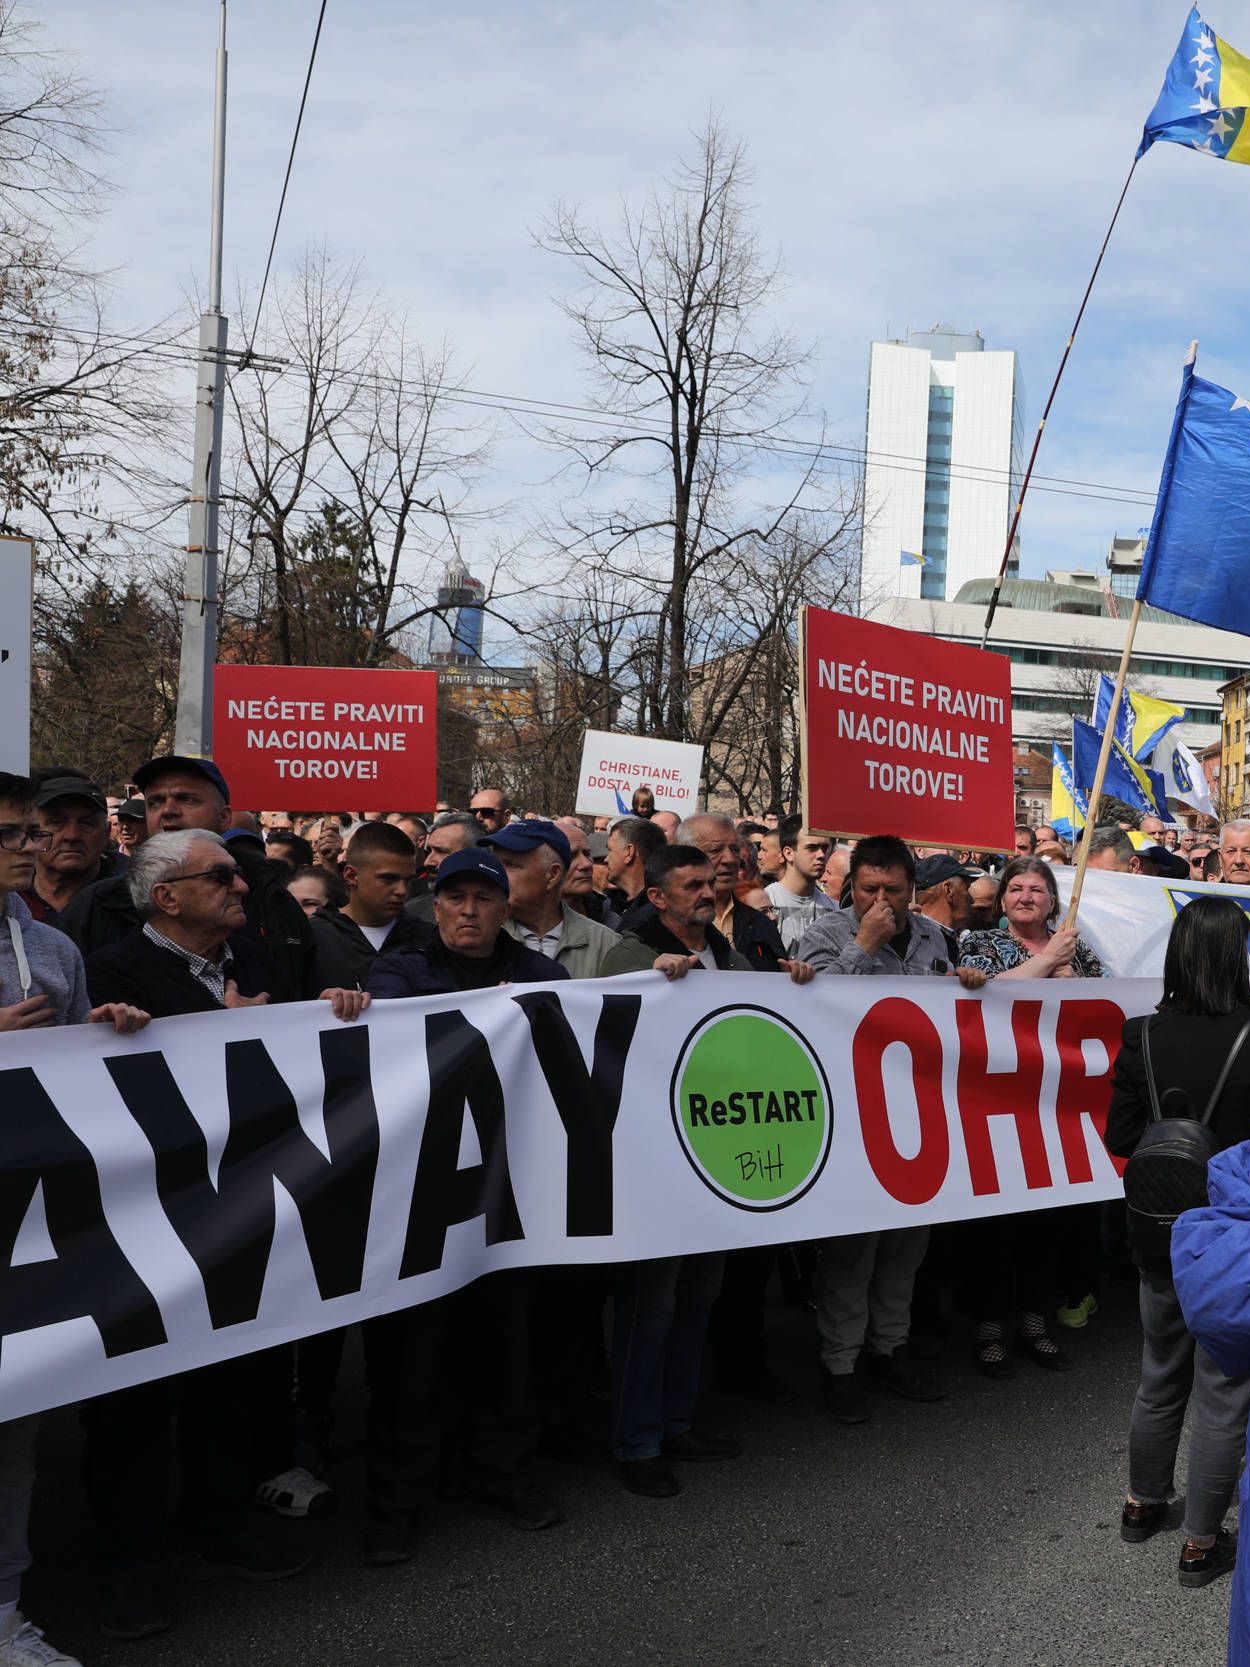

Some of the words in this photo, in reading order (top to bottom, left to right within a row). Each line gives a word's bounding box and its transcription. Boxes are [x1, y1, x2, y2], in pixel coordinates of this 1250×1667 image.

[227, 695, 325, 721] NEĆETE
[333, 702, 424, 724] PRAVITI
[818, 658, 915, 706] NEĆETE
[922, 681, 1005, 725] PRAVITI
[246, 729, 407, 752] NACIONALNE
[837, 708, 990, 764] NACIONALNE
[275, 759, 378, 779] TOROVE!
[587, 775, 631, 792] DOSTA
[655, 784, 690, 799] BILO!
[599, 760, 683, 783] CHRISTIANE,
[864, 760, 964, 801] TOROVE!
[689, 1090, 817, 1127] ReSTART
[0, 990, 642, 1370] AWAY
[852, 996, 1128, 1205] OHR
[735, 1144, 784, 1182] BiH
